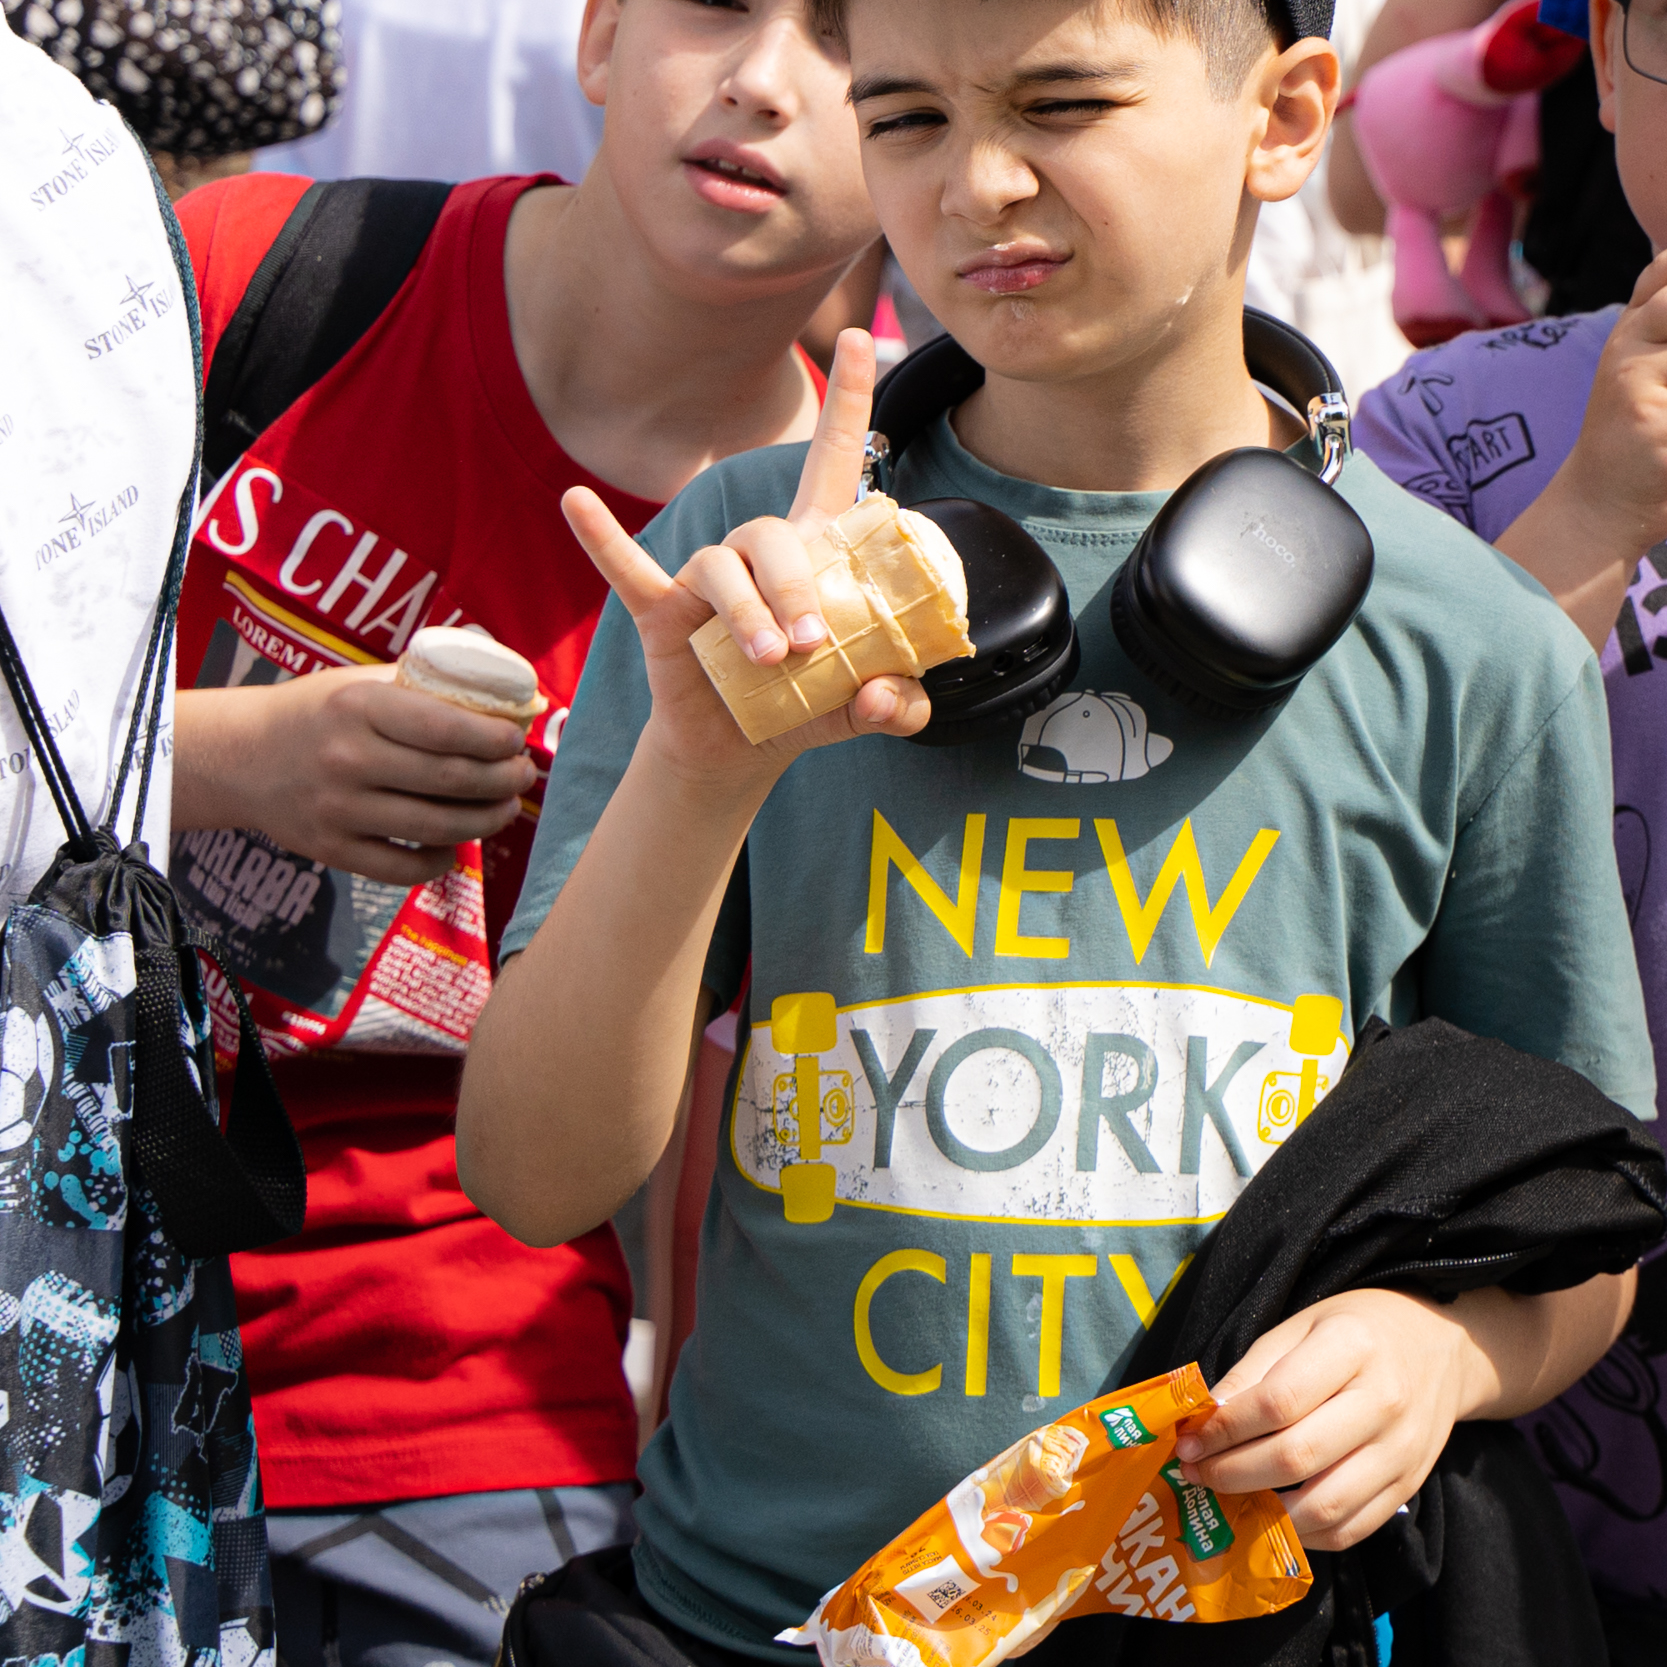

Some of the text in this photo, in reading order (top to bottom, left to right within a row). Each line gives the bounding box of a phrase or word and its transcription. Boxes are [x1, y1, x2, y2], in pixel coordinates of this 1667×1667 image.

[29, 158, 89, 212] STONE
[84, 307, 146, 361] STONE
[88, 484, 140, 538] ISLAND
[1253, 522, 1296, 568] hoco.
[232, 605, 310, 671] LOREM
[863, 807, 1281, 969] NEW
[850, 1026, 1268, 1178] YORK
[1182, 1487, 1215, 1553] Долина
